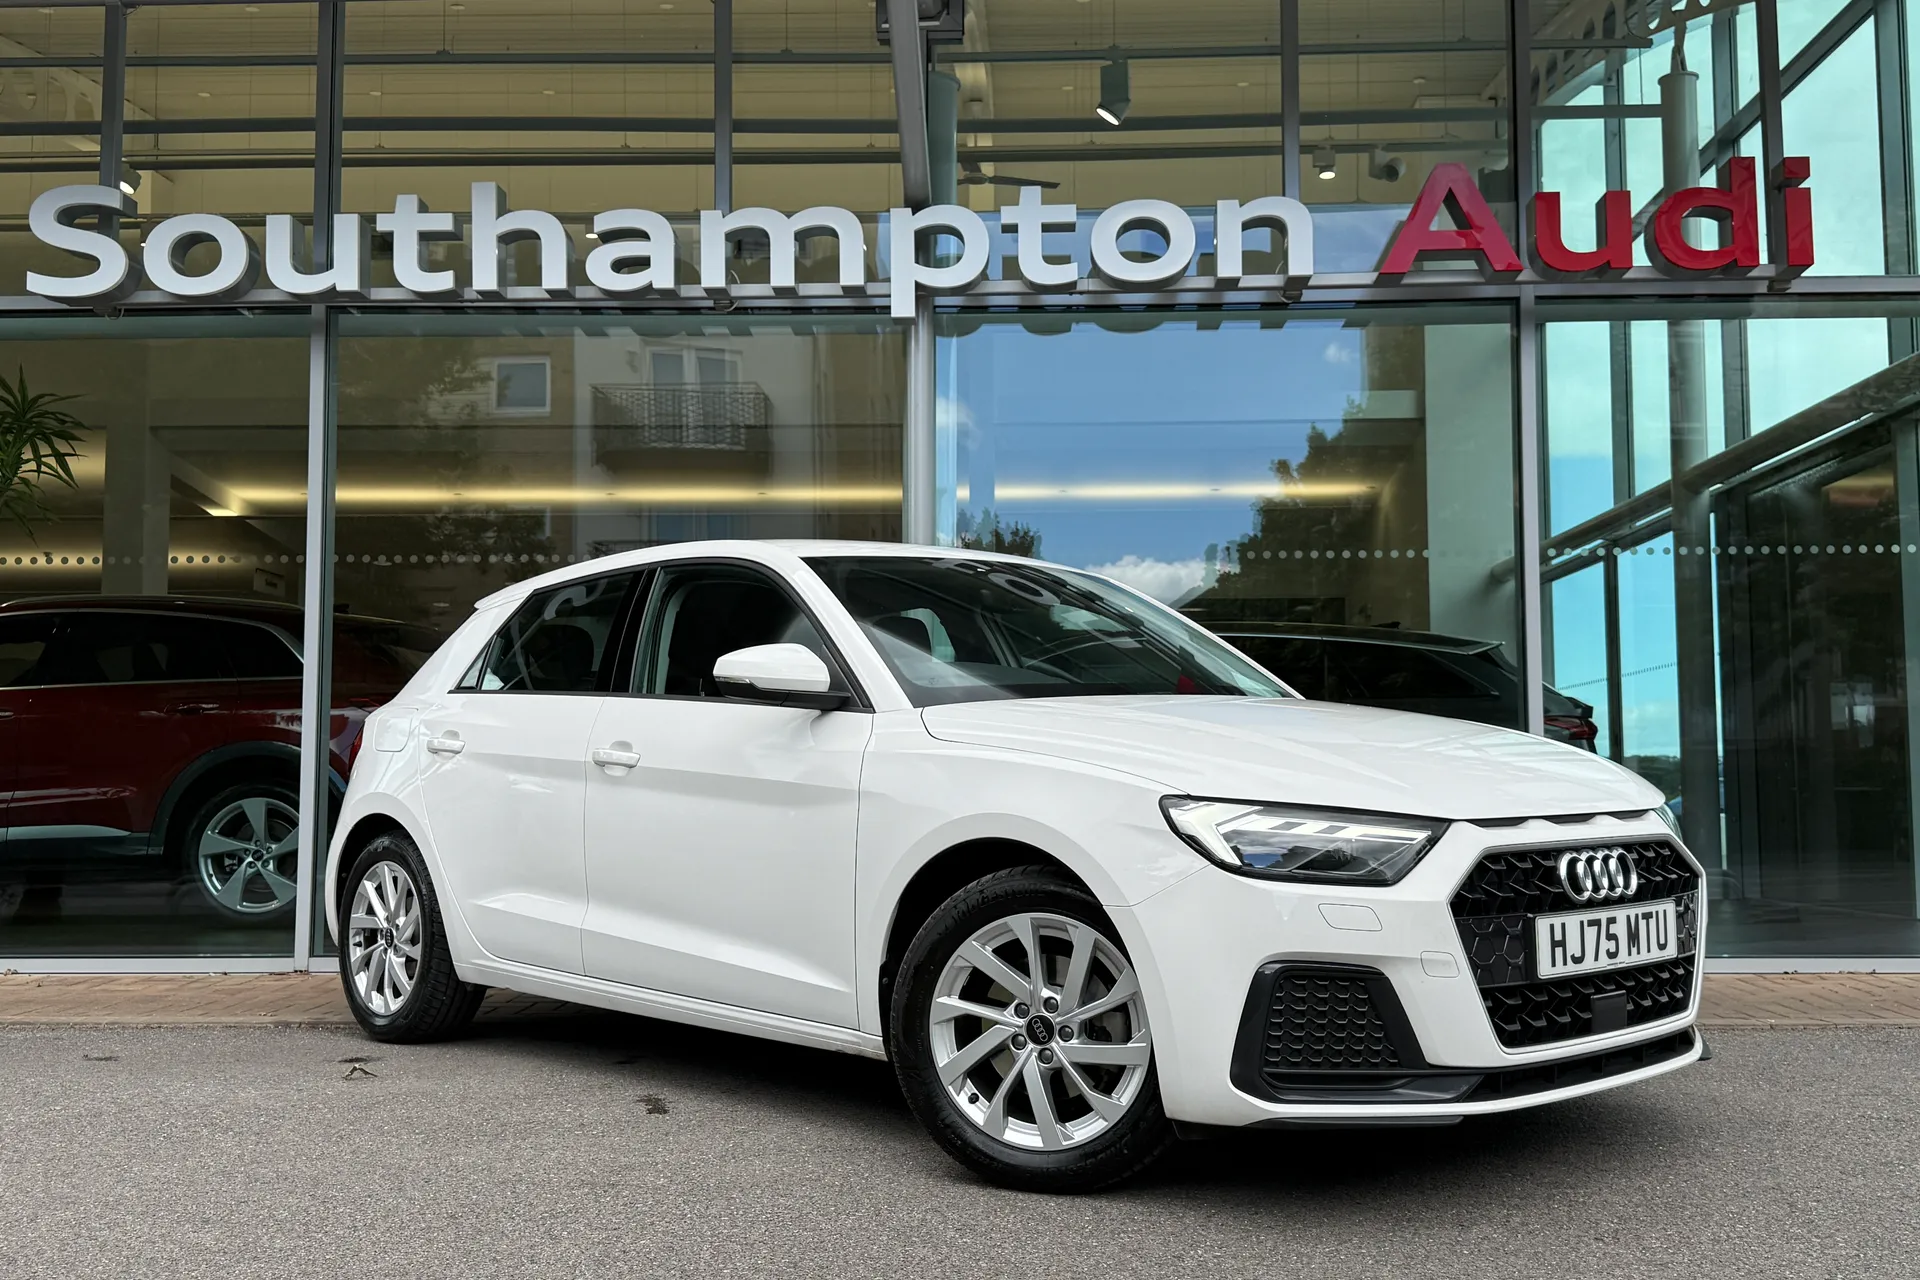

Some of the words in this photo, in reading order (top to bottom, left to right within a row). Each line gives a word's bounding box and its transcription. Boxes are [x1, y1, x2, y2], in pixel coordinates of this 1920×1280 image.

[26, 181, 1314, 319] Southampton
[1380, 156, 1814, 275] Audi
[1549, 916, 1620, 968] HJ75
[1625, 909, 1668, 957] MTU
